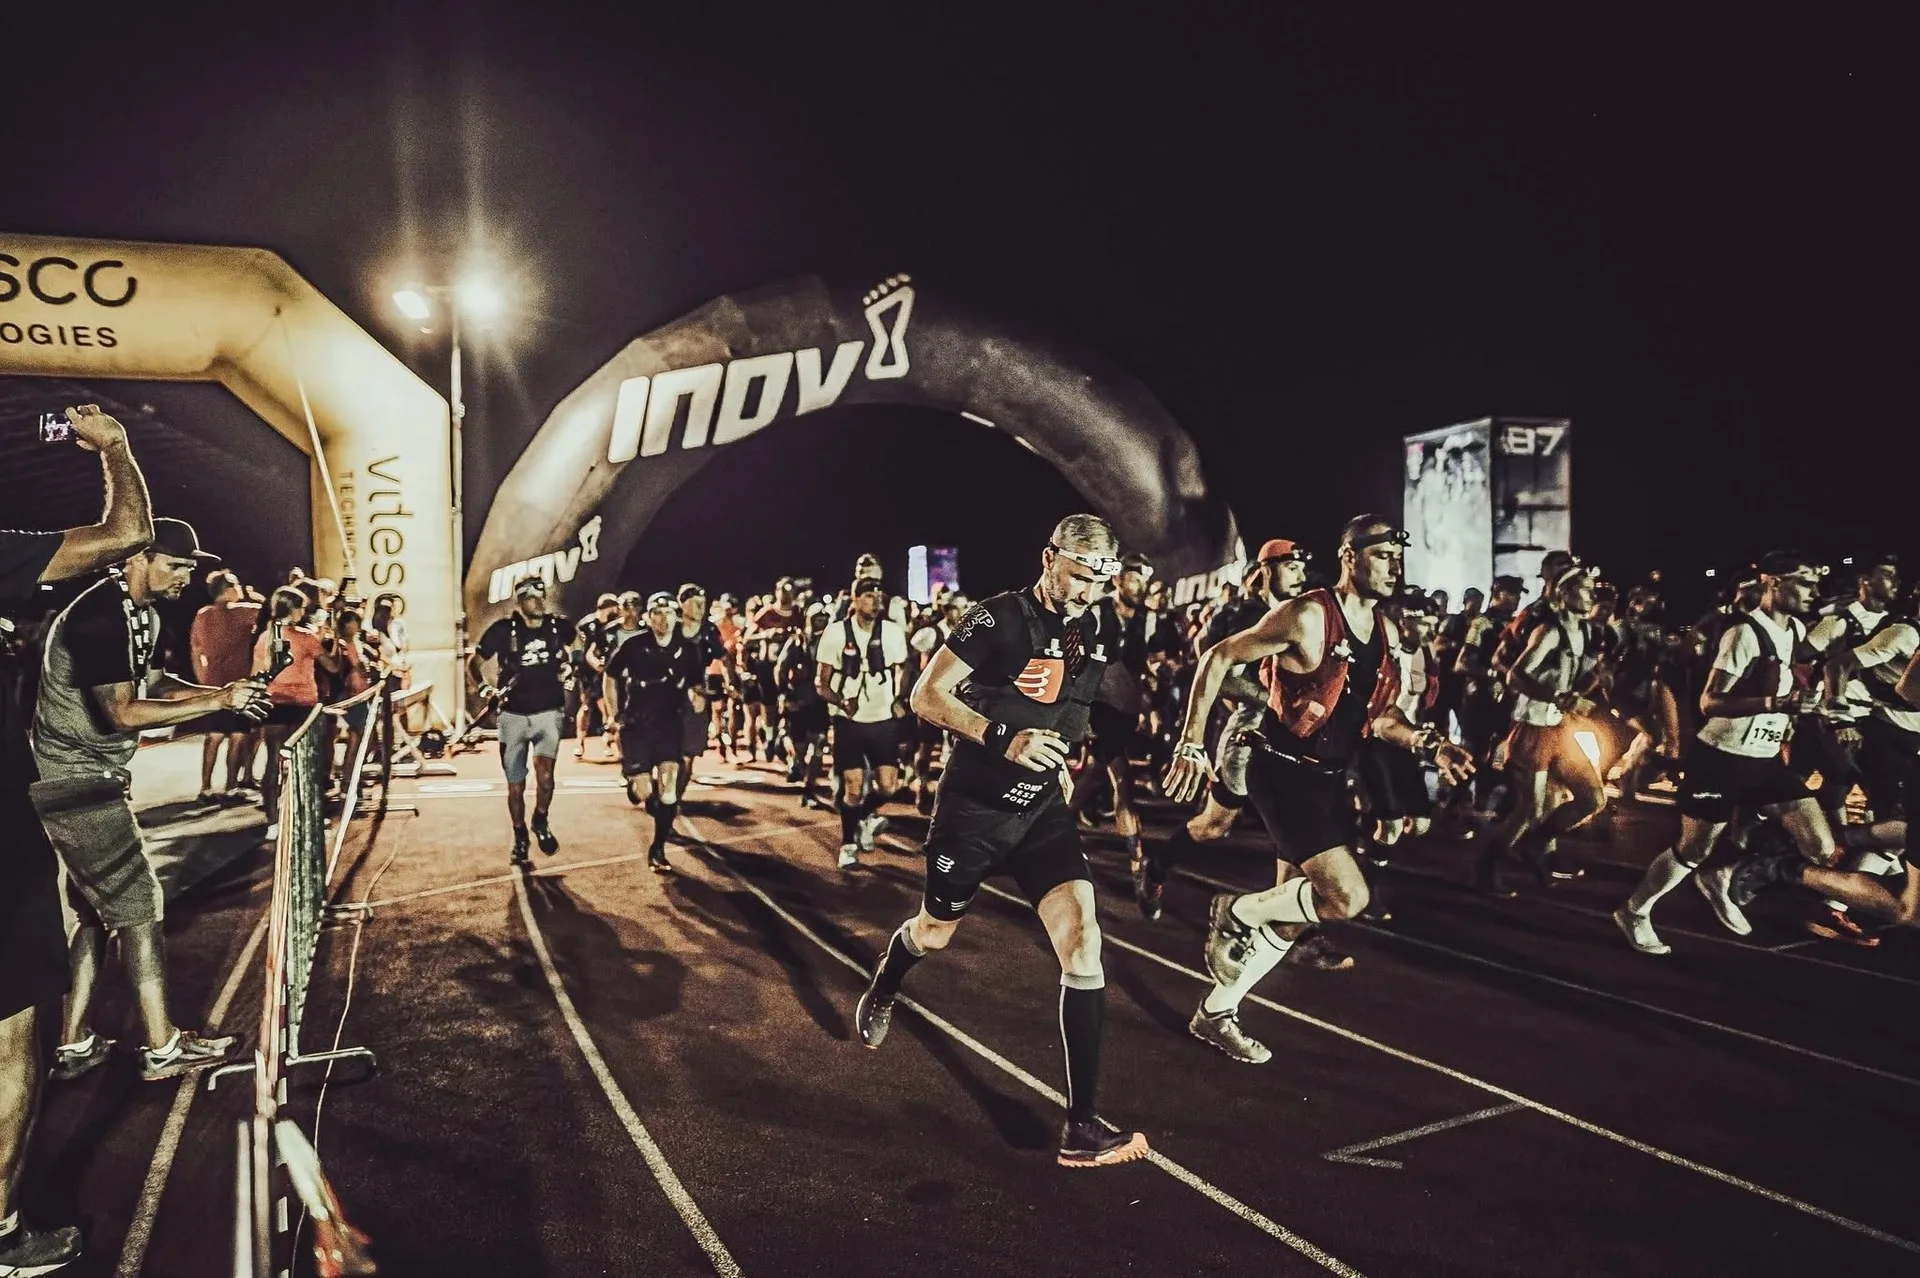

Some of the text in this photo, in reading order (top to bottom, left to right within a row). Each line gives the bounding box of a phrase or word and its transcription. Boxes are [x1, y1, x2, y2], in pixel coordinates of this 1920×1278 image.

[0, 322, 118, 348] OGIES
[1009, 787, 1037, 800] RESS
[1016, 782, 1043, 792] COMP
[1002, 793, 1031, 807] PORT
